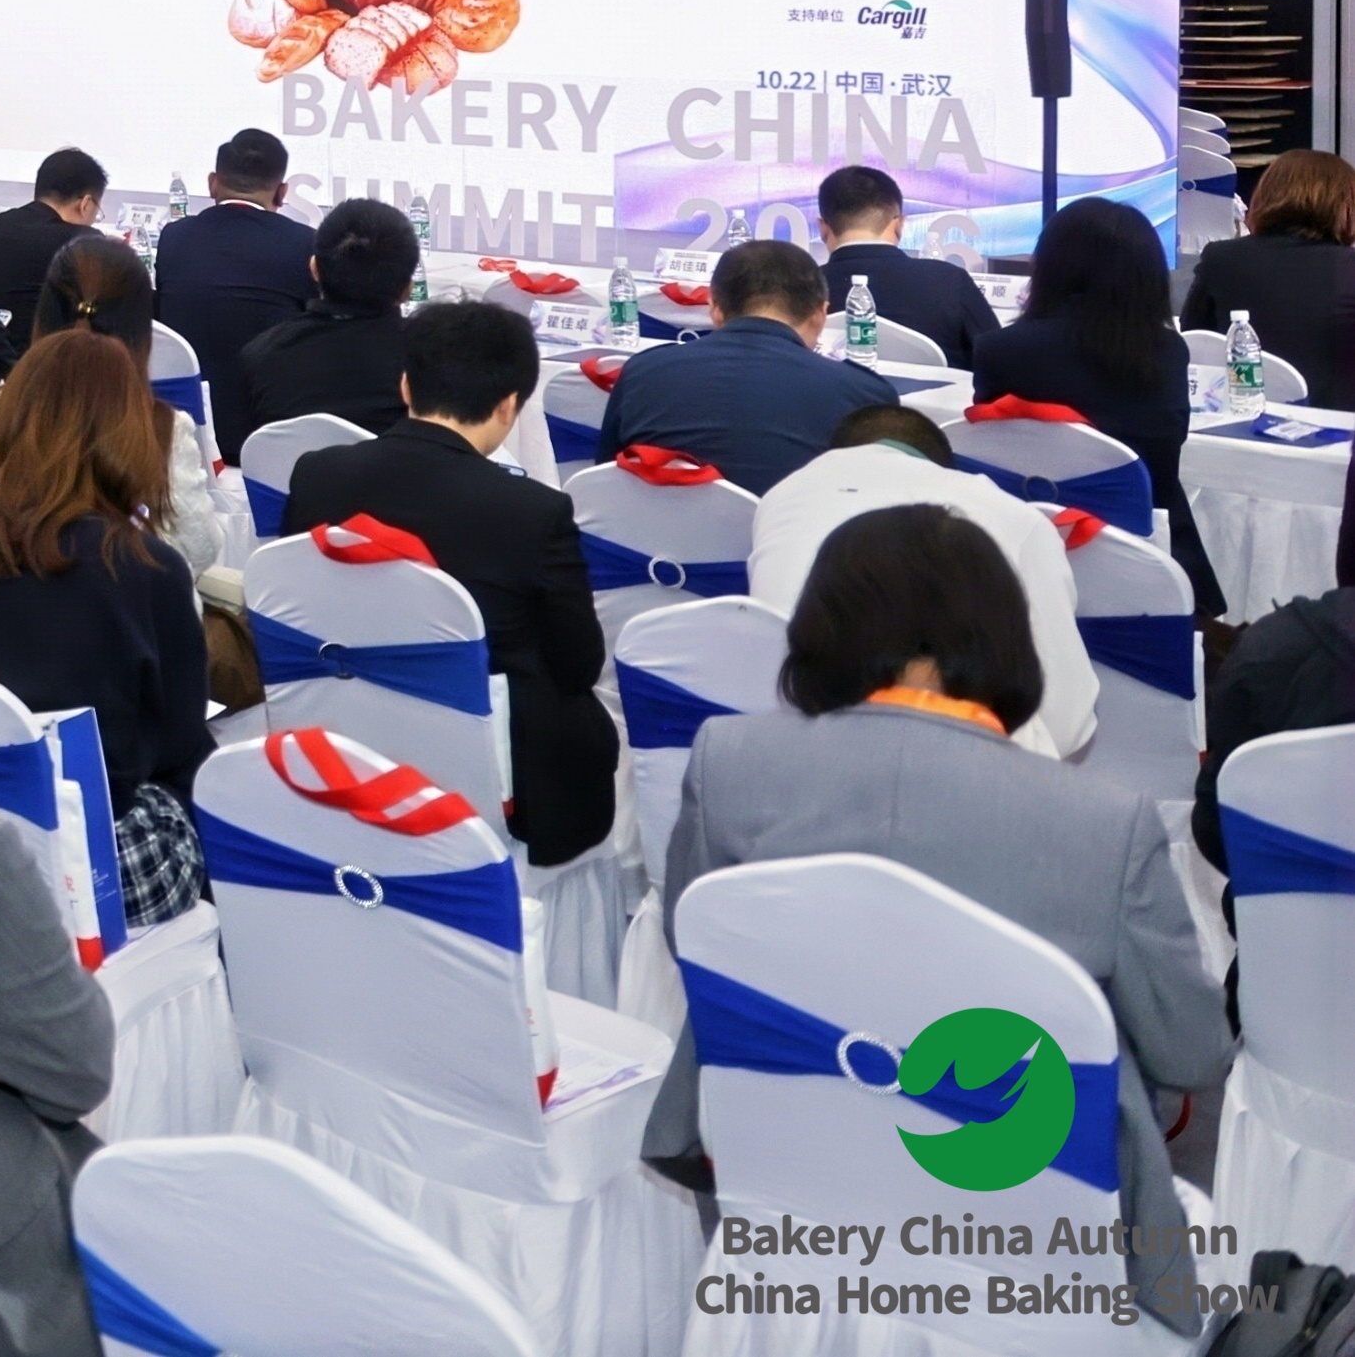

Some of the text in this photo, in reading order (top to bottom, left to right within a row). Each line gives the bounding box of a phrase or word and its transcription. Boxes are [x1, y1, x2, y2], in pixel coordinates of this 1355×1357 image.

[788, 9, 844, 22] 支持单位
[857, 5, 928, 29] Cargill
[756, 70, 817, 90] 10.22
[282, 72, 988, 174] BAKERY CHINA
